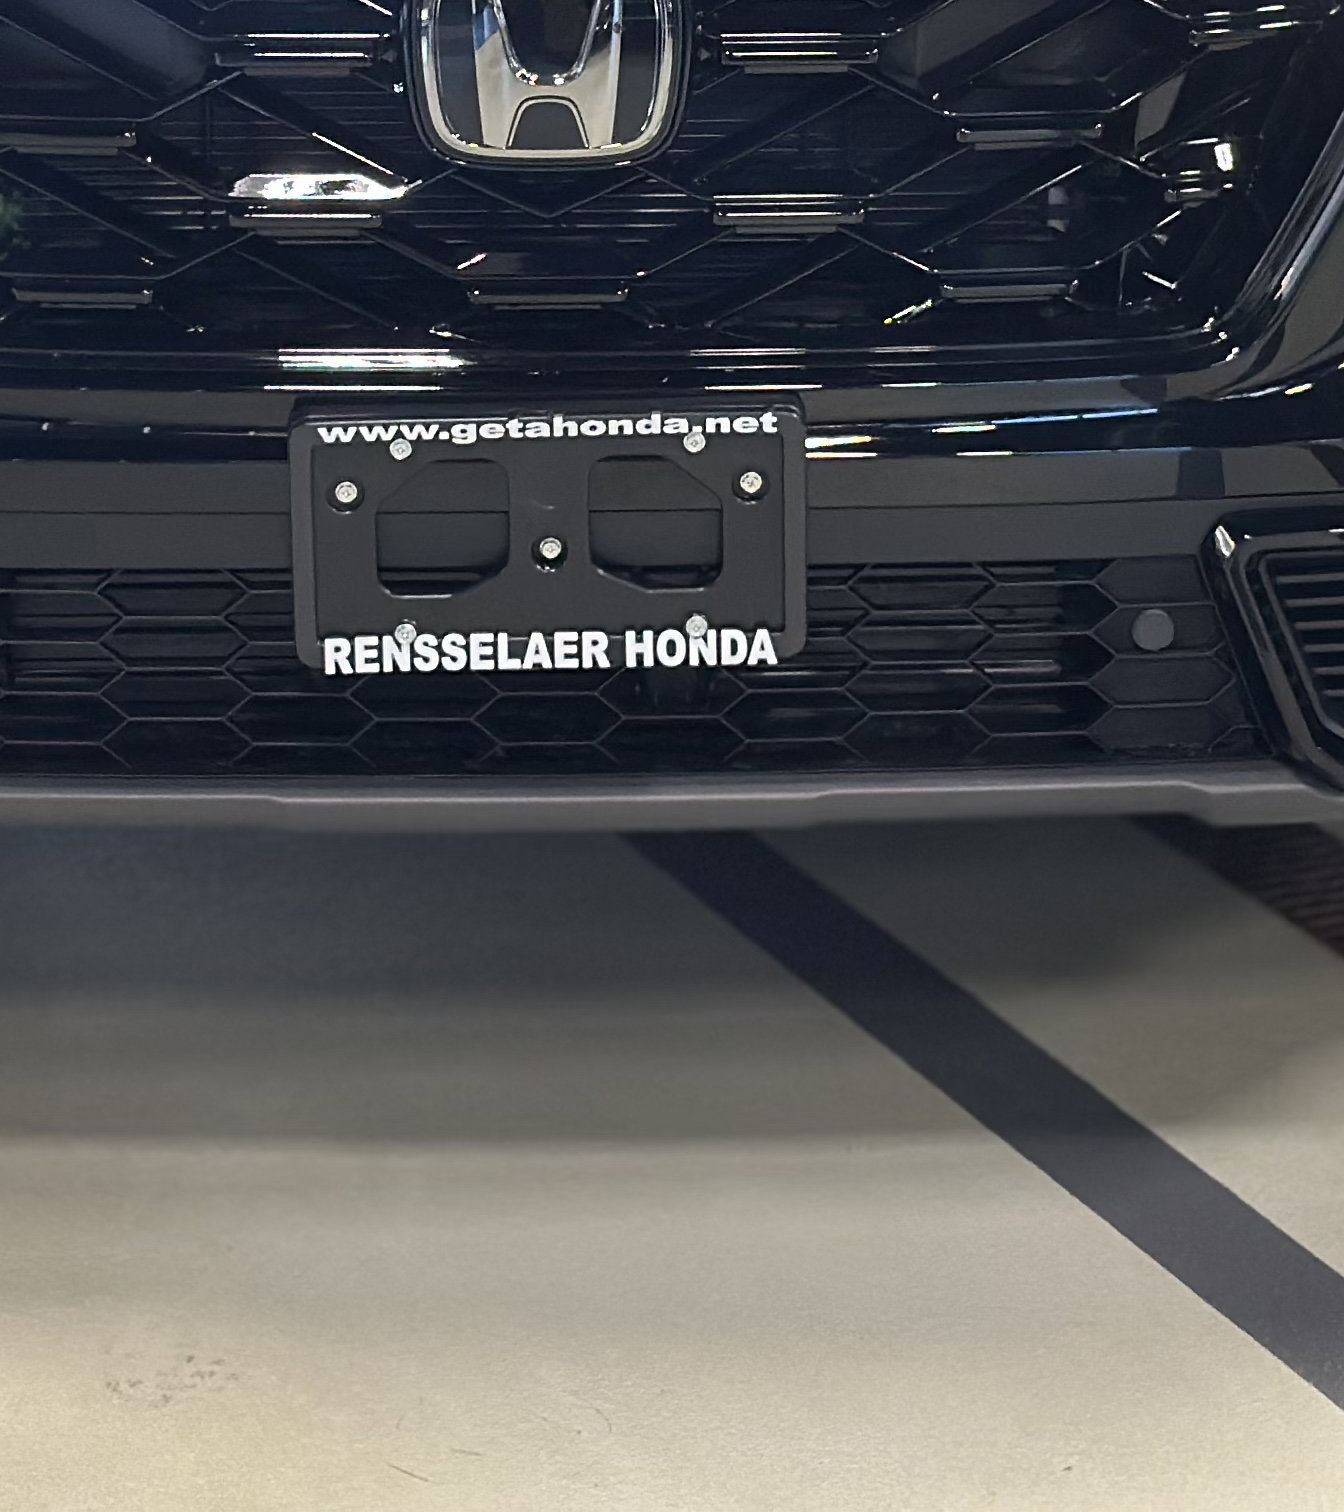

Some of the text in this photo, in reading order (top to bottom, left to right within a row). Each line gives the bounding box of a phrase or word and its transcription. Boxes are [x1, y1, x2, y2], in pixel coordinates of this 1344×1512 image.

[317, 411, 778, 444] www.getahonda.net
[324, 629, 778, 675] RENSSELAER HONDA
